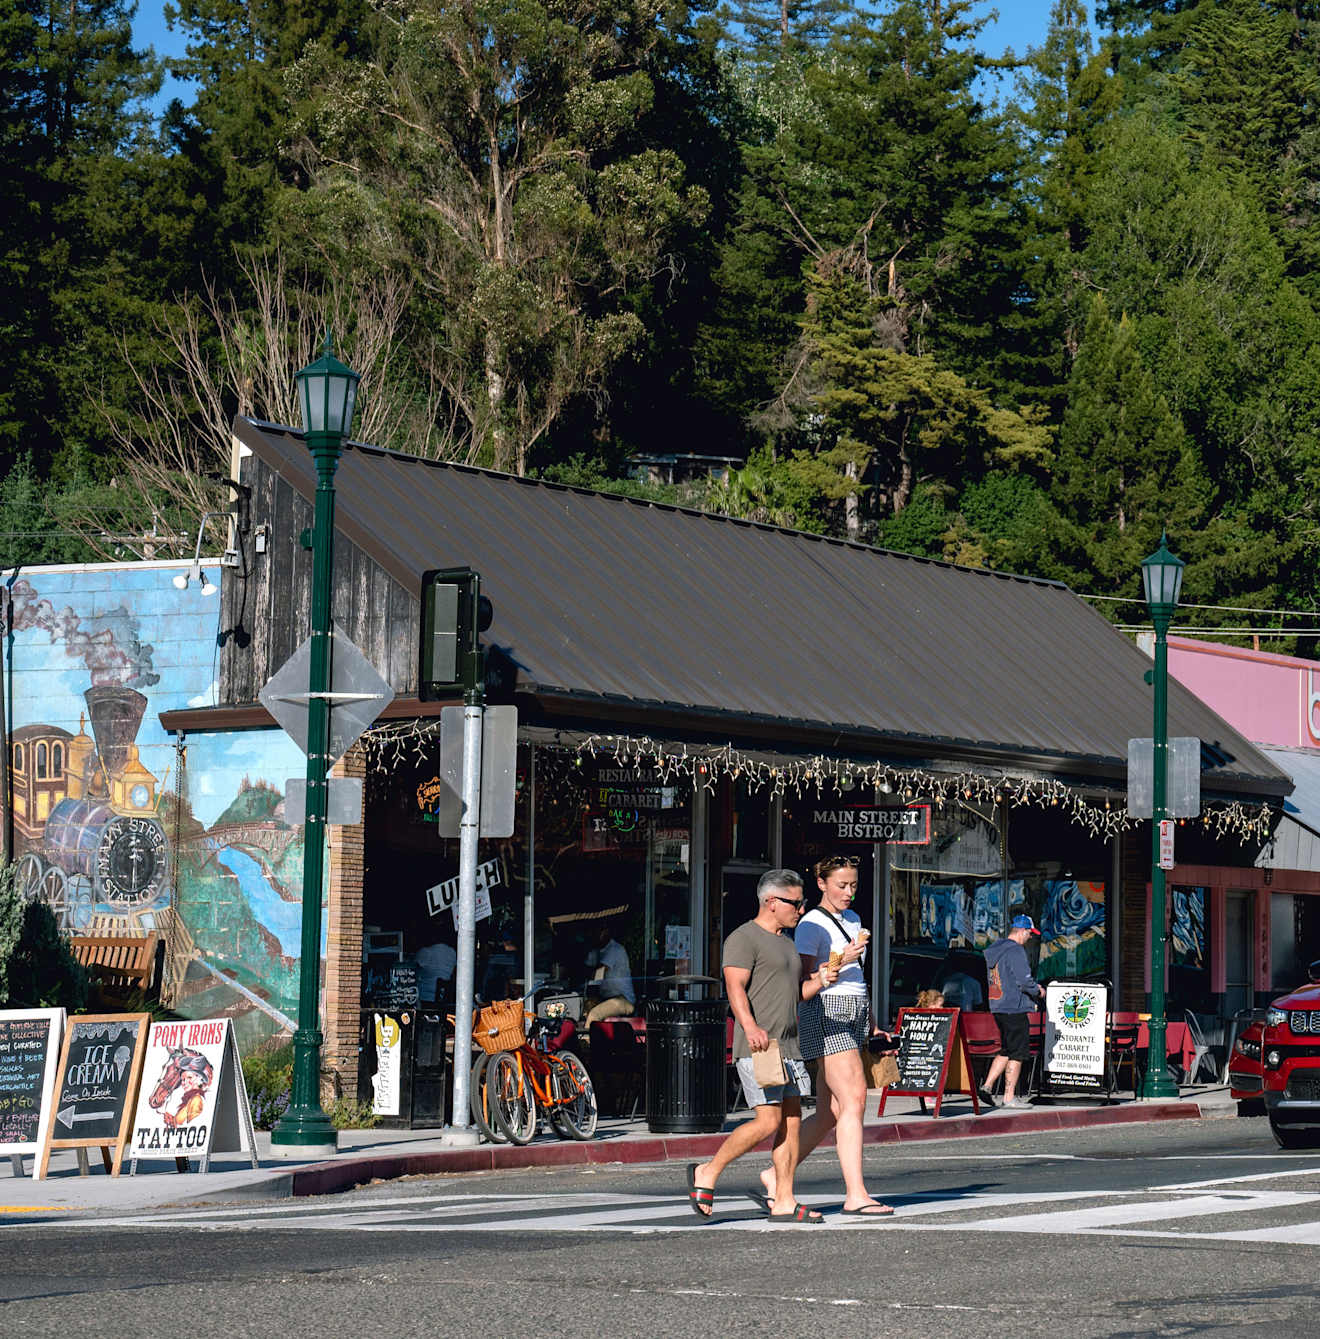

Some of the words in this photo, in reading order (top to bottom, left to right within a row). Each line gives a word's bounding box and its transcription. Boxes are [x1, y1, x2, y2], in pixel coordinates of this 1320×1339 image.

[814, 810, 854, 823] MAIN
[859, 811, 919, 824] STREET
[838, 824, 894, 838] BISTRO
[103, 879, 158, 905] STATION
[428, 860, 499, 914] LUCH
[153, 1025, 186, 1047] PONY
[187, 1022, 223, 1046] IRONS
[909, 1021, 939, 1032] HAPPY
[909, 1032, 934, 1041] HOUR
[84, 1045, 112, 1065] ICE
[1059, 1044, 1090, 1052] CABARET
[1048, 1052, 1080, 1061] OUTDOOR
[1082, 1054, 1101, 1062] PATIO
[68, 1063, 114, 1086] CREAM
[137, 1125, 207, 1149] TATTOO
